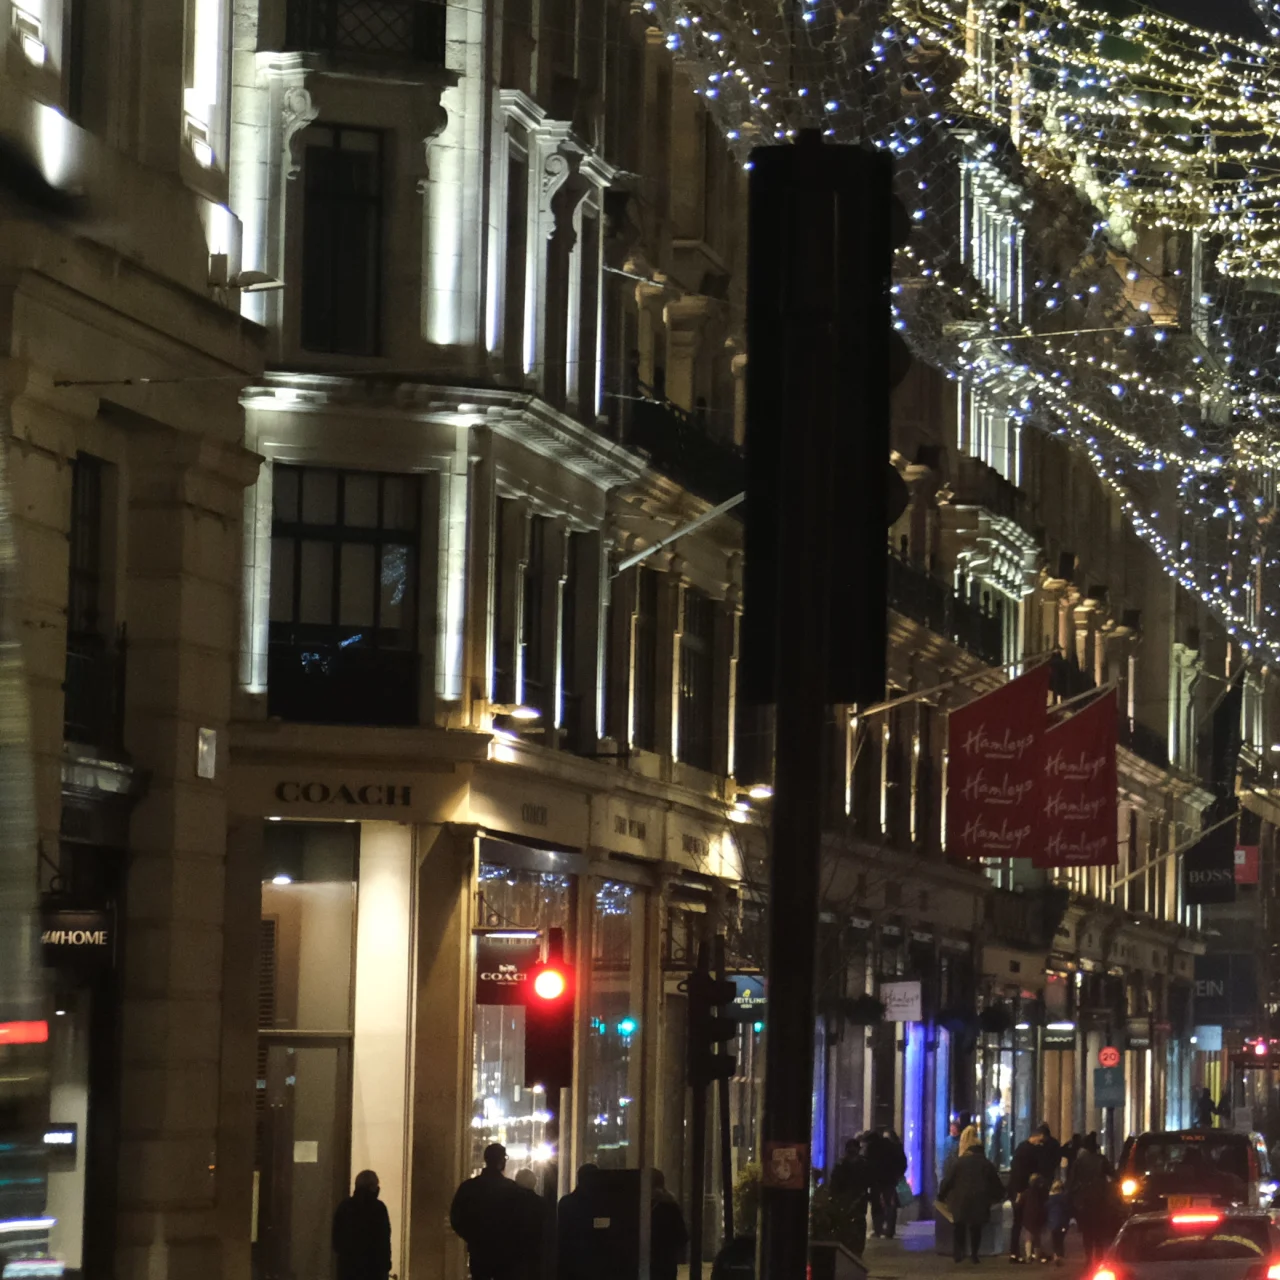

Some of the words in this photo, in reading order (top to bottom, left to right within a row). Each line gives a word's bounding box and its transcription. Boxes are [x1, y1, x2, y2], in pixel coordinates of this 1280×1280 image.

[962, 723, 1034, 758] Hamleys
[1045, 749, 1106, 778] Hamleys
[274, 781, 412, 806] COACH
[961, 768, 1033, 804] Hamleys
[1044, 788, 1106, 819] Hamleys
[961, 813, 1031, 849] Hamleys
[1044, 829, 1107, 859] Hamleys
[1189, 868, 1232, 883] BOSS
[60, 930, 108, 945] HOME
[1103, 1053, 1116, 1061] 20
